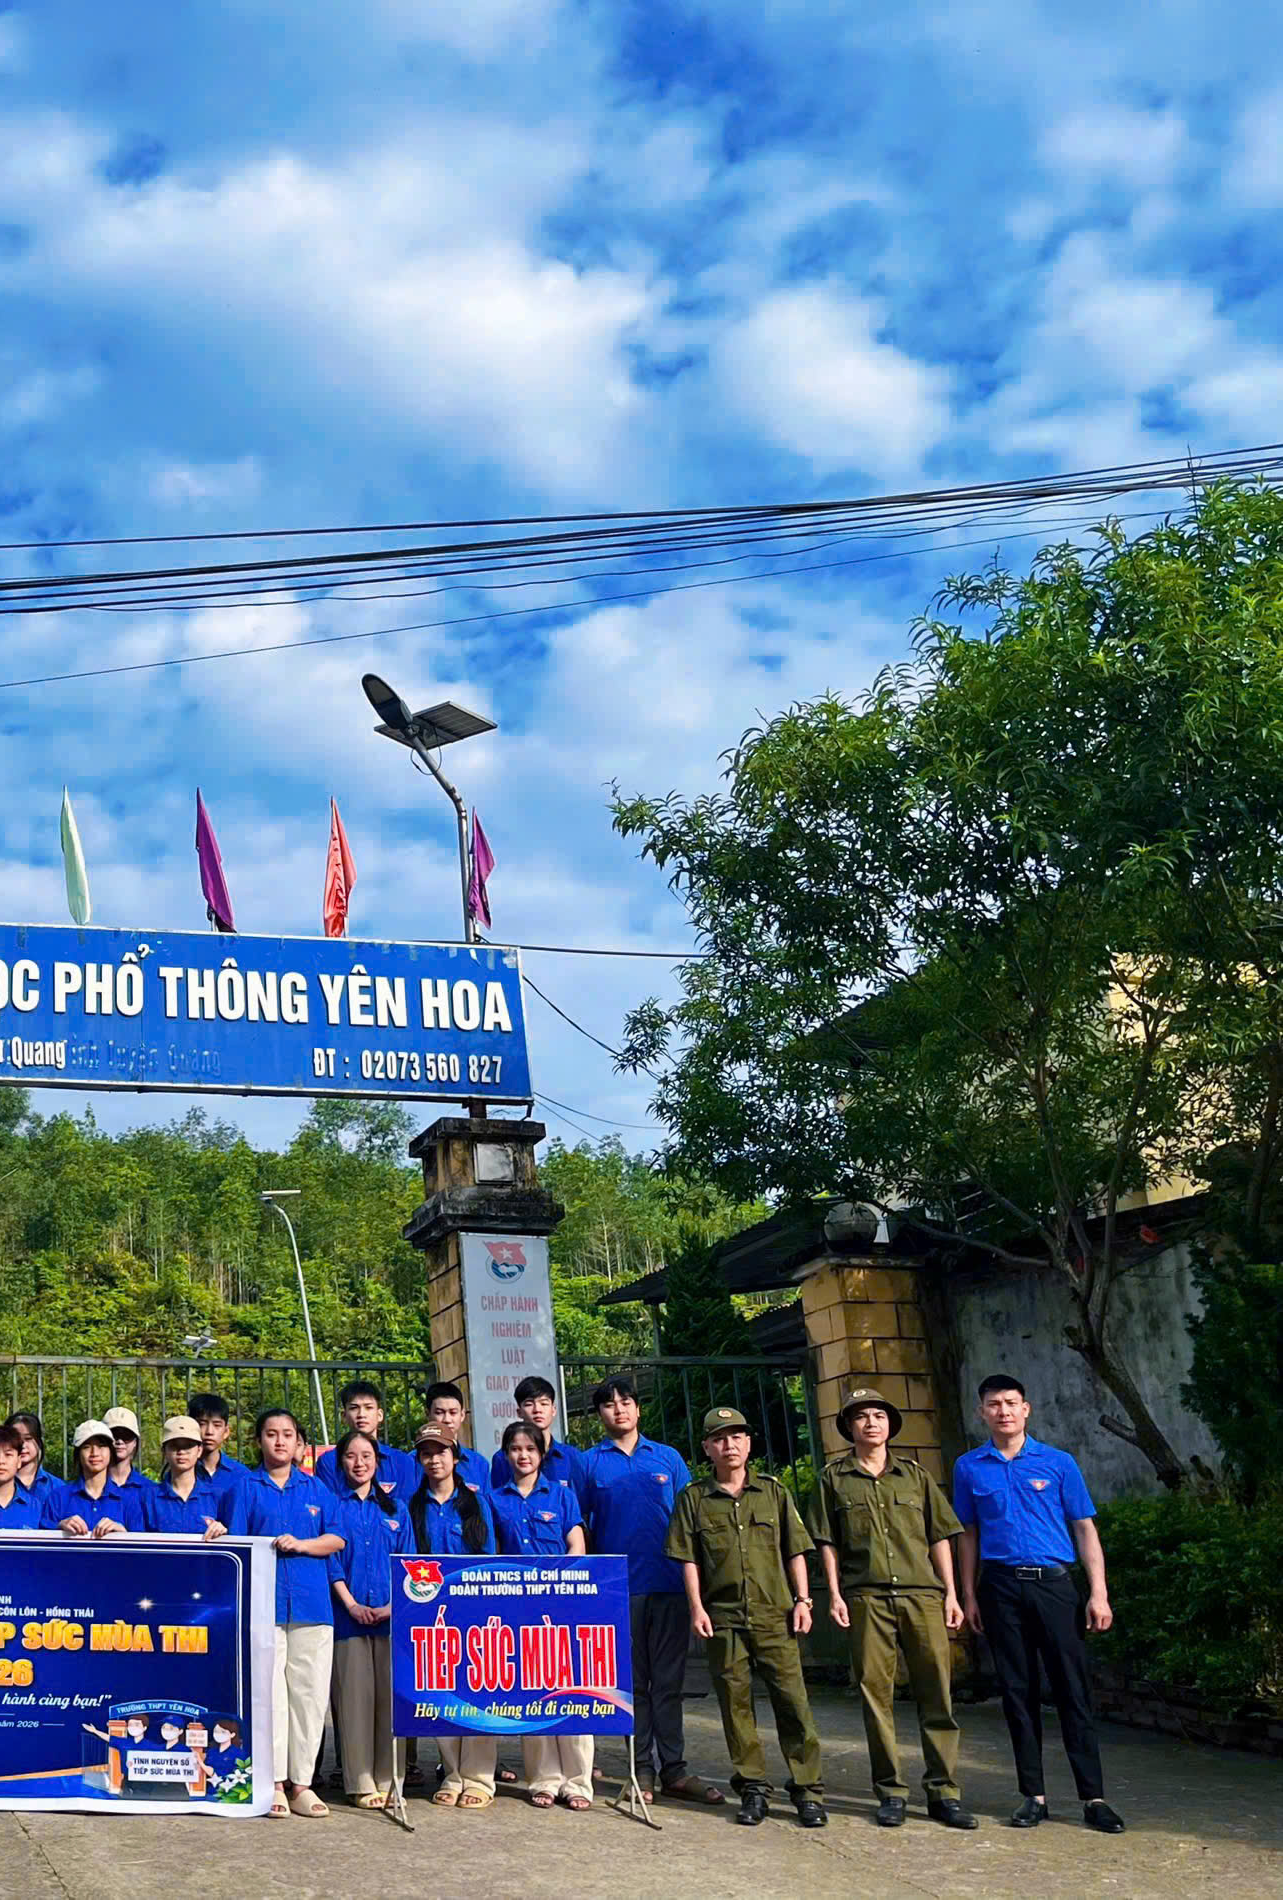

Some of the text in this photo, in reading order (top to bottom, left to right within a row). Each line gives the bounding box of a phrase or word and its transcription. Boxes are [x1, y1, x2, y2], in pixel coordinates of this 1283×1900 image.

[54, 943, 150, 1016] PHỔ
[159, 957, 309, 1024] THÔNG
[319, 964, 408, 1027] YÊN
[421, 978, 513, 1032] HOA
[11, 1036, 67, 1069] Quang
[361, 1049, 420, 1081] 02073
[426, 1052, 460, 1082] 560
[468, 1055, 502, 1083] 827
[511, 1291, 539, 1312] HÀNH
[492, 1320, 532, 1338] NGHIÊM
[501, 1346, 526, 1368] LUẬT
[486, 1376, 509, 1391] GIAO
[461, 1569, 492, 1582] ĐOÀN
[493, 1571, 521, 1582] TNCS
[541, 1568, 558, 1582] CHÍ
[561, 1570, 589, 1582] MINH
[449, 1582, 598, 1596] ĐOÀN TRƯỜNG THPT YÊN HOA
[19, 1606, 37, 1616] LÔN
[73, 1607, 94, 1618] THÁI
[22, 1618, 84, 1650] SỨC
[90, 1619, 154, 1651] MÙA
[158, 1625, 208, 1653] THI
[411, 1605, 617, 1692] TIẾP SỨC MÙA THI
[2, 1692, 36, 1706] hành
[38, 1693, 70, 1709] cùng
[117, 1703, 146, 1714] TRƯỜNG
[169, 1703, 182, 1711] YÊN
[184, 1706, 199, 1715] HOA
[414, 1703, 440, 1720] Hãy
[444, 1704, 458, 1720] tự
[484, 1701, 522, 1719] chúng
[525, 1702, 542, 1716] tôi
[545, 1700, 557, 1716] đi
[560, 1702, 589, 1718] cùng
[592, 1700, 616, 1718] bạn
[17, 1720, 39, 1728] 2026
[133, 1757, 149, 1765] TÌNH
[151, 1758, 178, 1766] NGUYỆN
